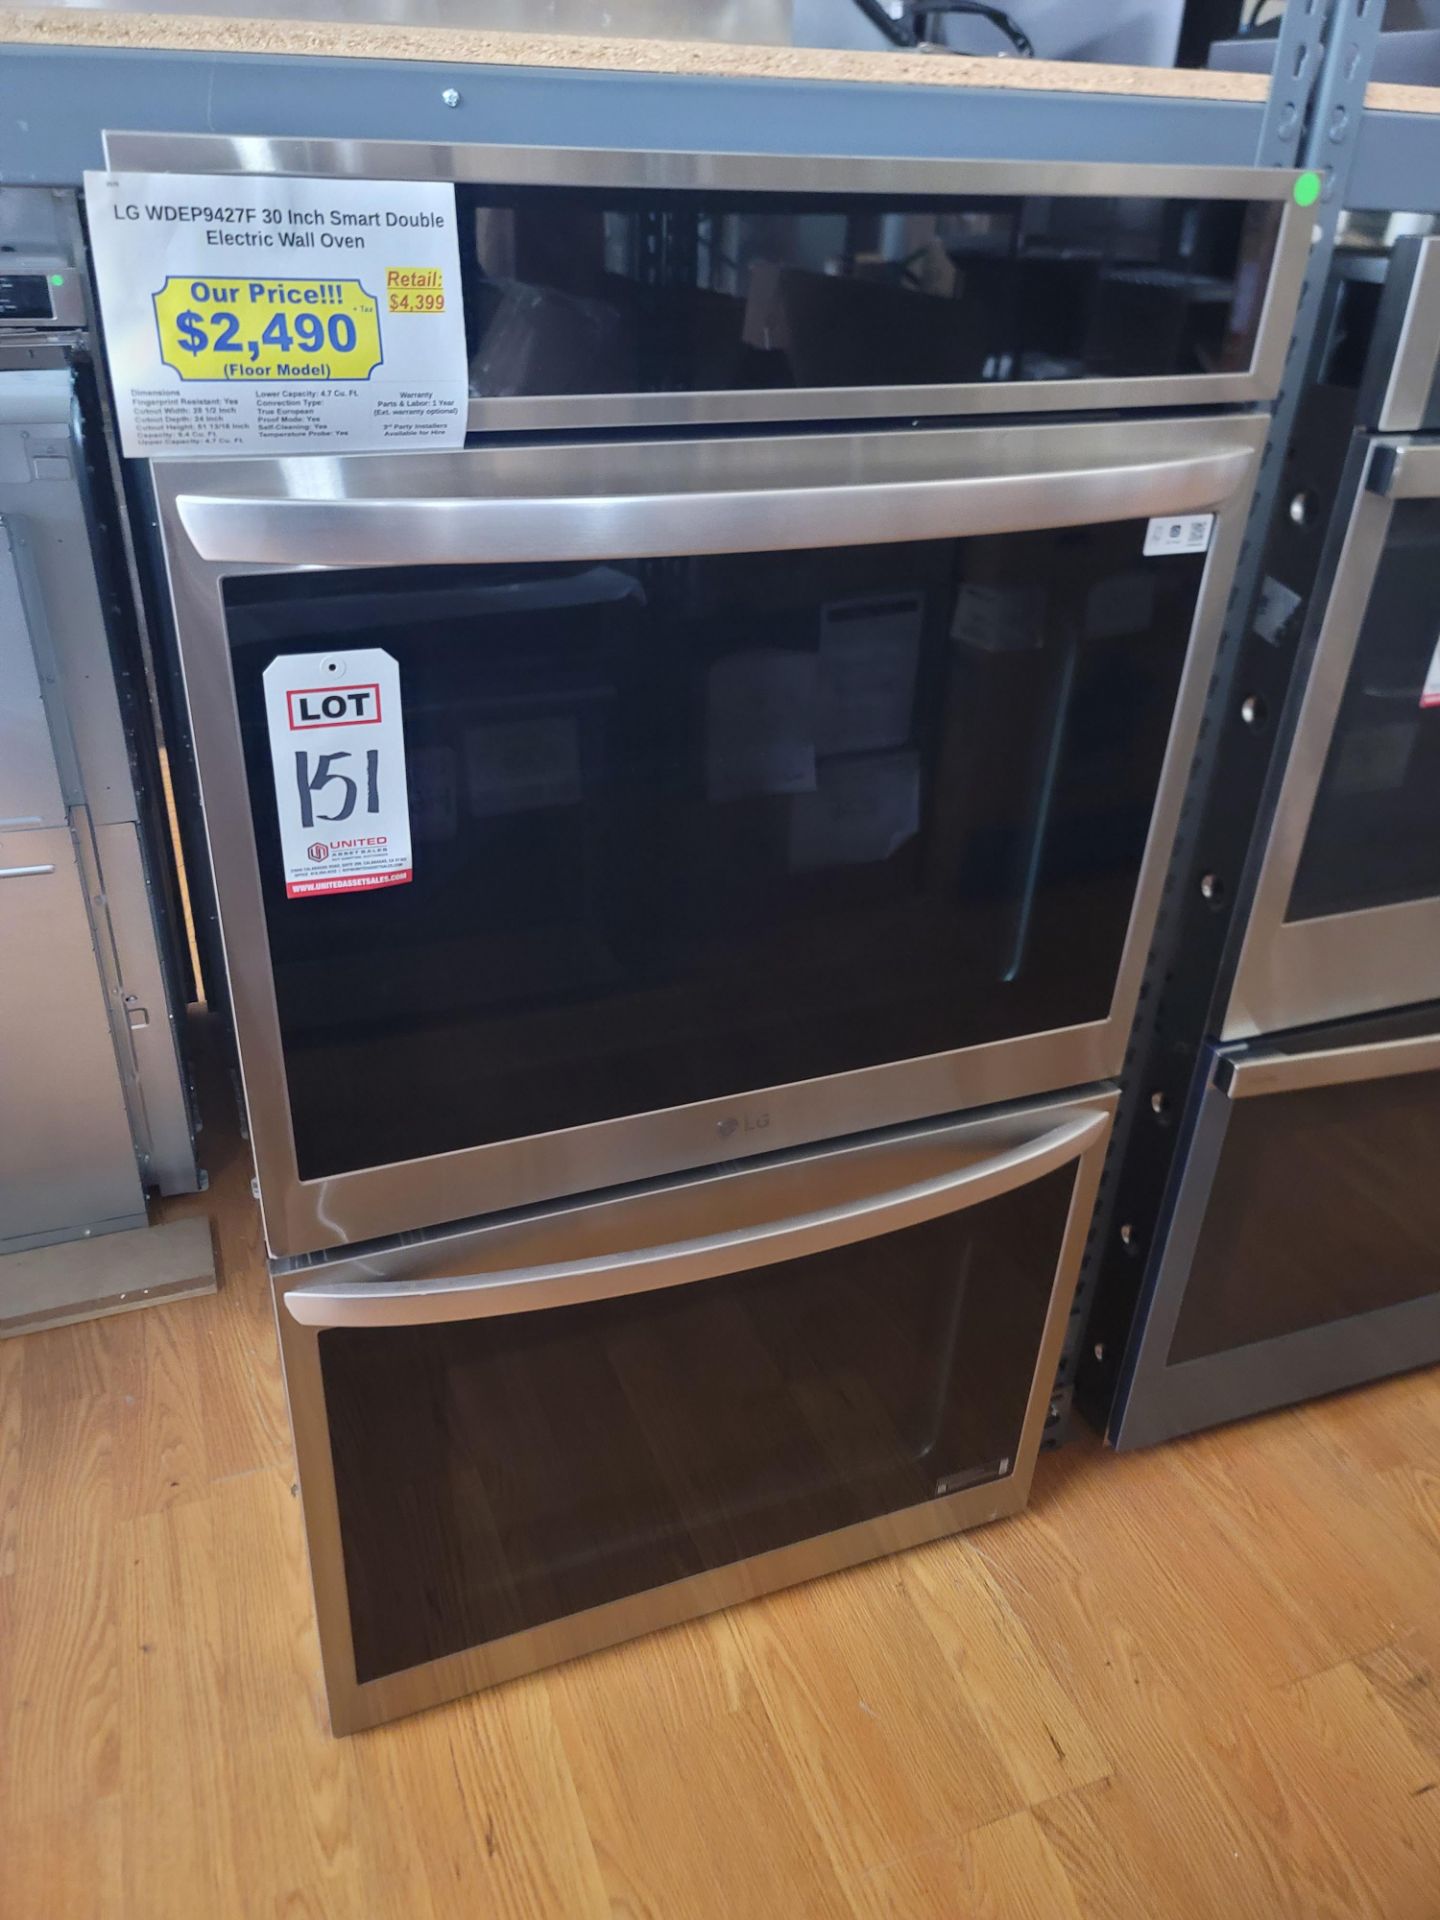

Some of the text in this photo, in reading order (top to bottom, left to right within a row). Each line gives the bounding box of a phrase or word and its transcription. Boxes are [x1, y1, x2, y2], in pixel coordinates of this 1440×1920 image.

[114, 204, 445, 229] LG WDEP9427F 30 Inch Smart Double
[206, 230, 365, 249] Electric Wall Oven
[387, 271, 444, 288] Retail:
[190, 281, 343, 304] Our Price!!!
[389, 294, 446, 312] $4,399
[176, 308, 357, 362] $2,490
[224, 364, 331, 380] (Floor Model)
[131, 389, 180, 397] Dimensions
[255, 390, 281, 398] Lower
[282, 390, 318, 399] Capacity:
[399, 392, 434, 400] Warranty
[256, 399, 302, 407] Convection
[377, 400, 398, 408] Parts
[277, 408, 315, 416] European
[393, 409, 425, 417] warranty
[426, 408, 459, 416] optional)
[299, 692, 371, 721] LOT
[294, 749, 380, 828] 151
[329, 836, 388, 849] UNITED
[291, 872, 407, 893] WWW.UNITEDASSETSALES.COM
[743, 1112, 770, 1136] LG
